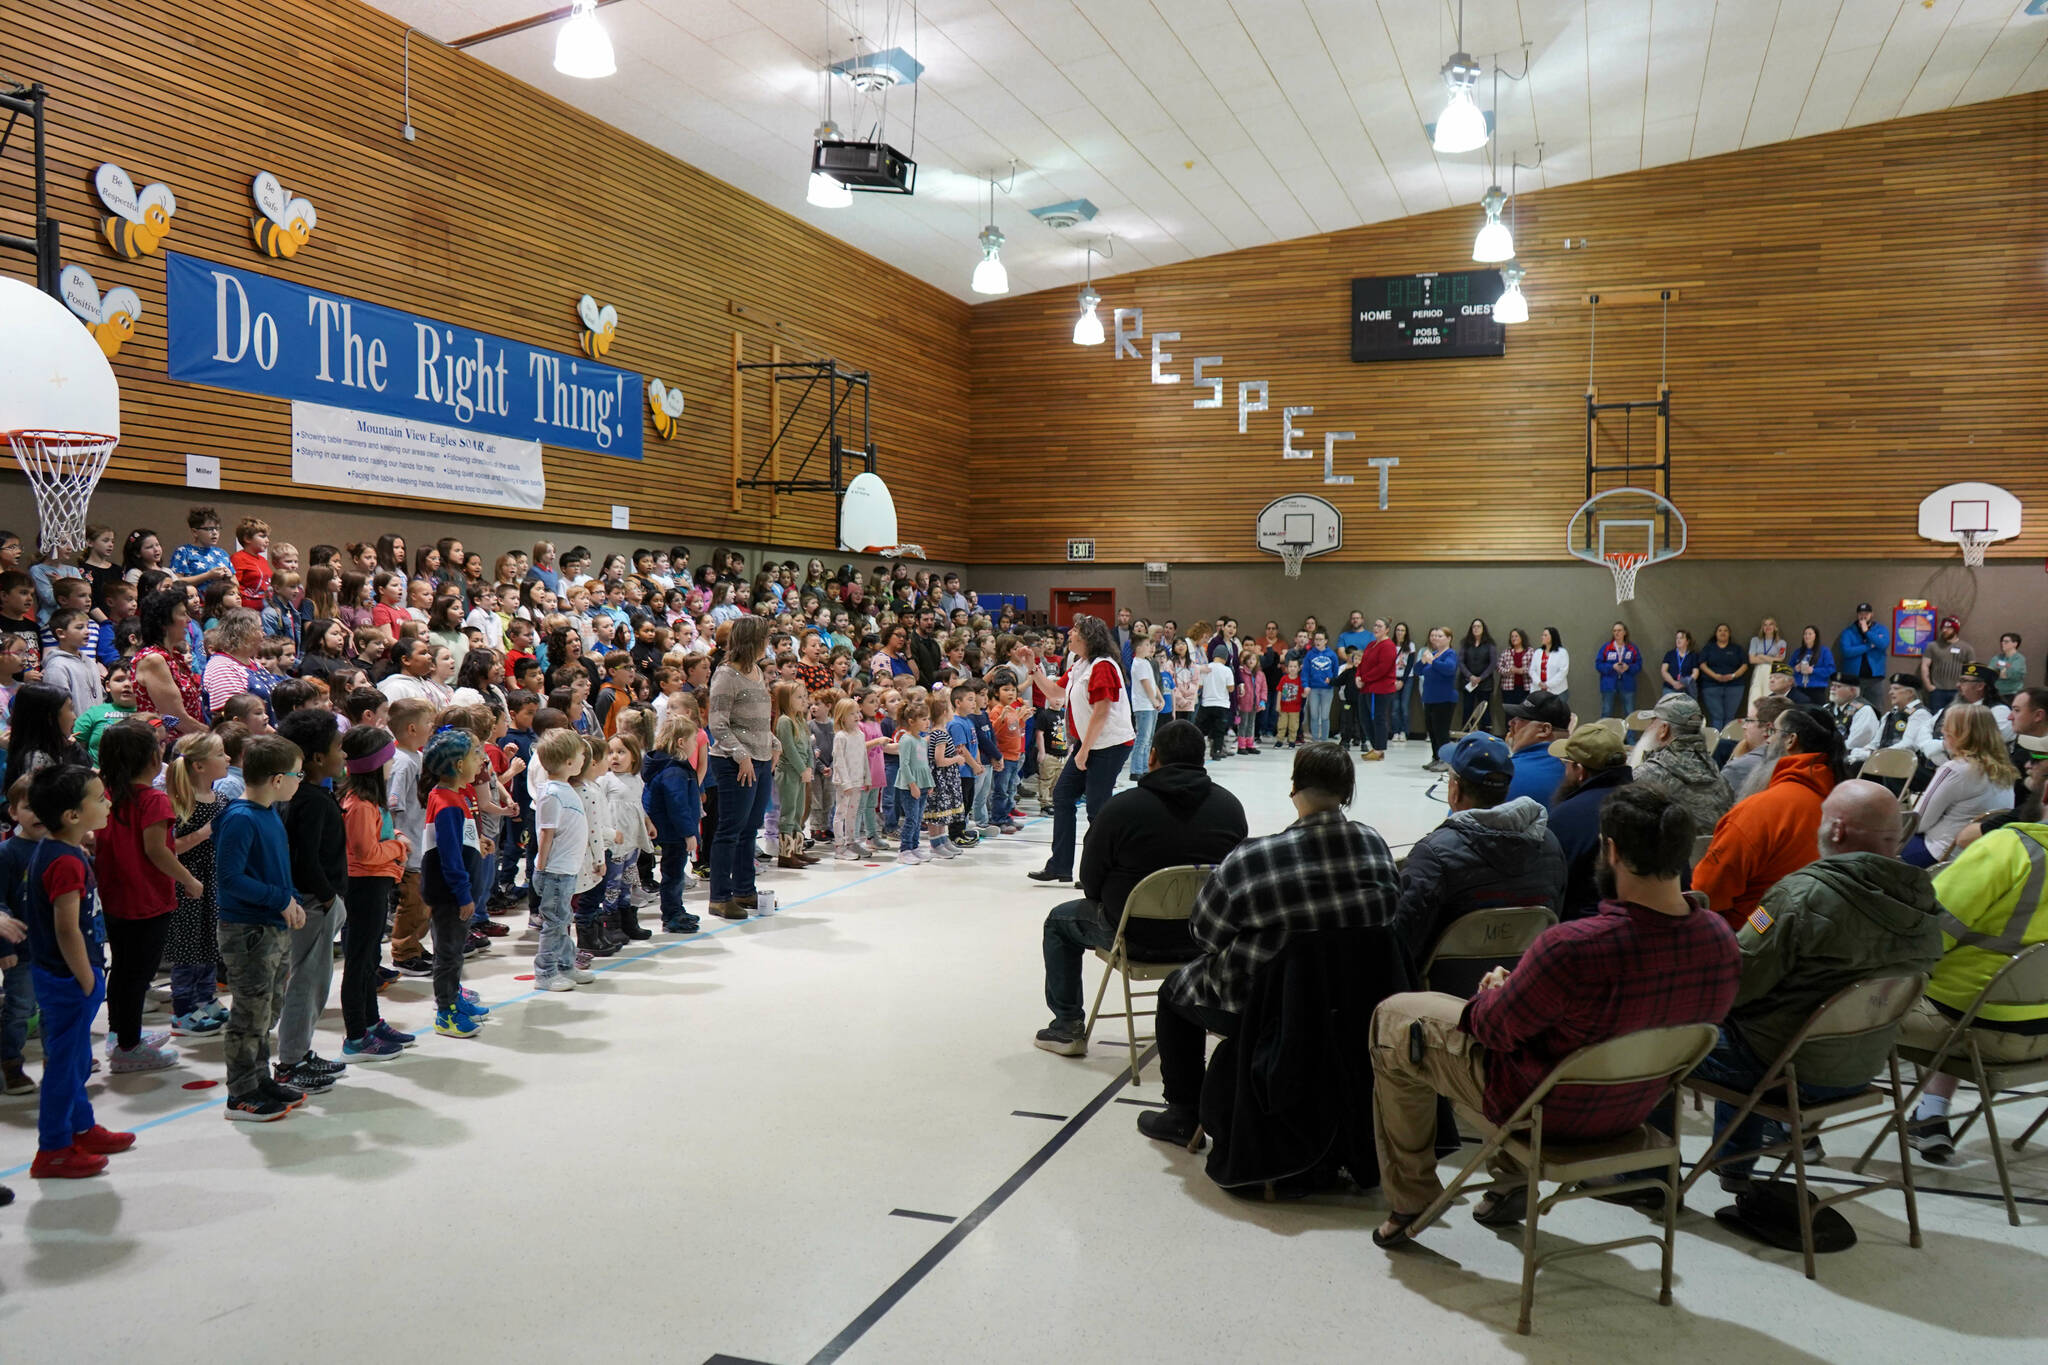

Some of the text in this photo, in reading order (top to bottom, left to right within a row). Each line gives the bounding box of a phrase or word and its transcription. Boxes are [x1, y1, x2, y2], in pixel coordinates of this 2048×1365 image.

[111, 175, 123, 187] Be
[265, 182, 275, 195] Be
[102, 188, 139, 214] Respectful
[263, 197, 279, 214] Safe
[73, 275, 85, 289] Be
[67, 291, 101, 317] Positive
[1360, 310, 1392, 322] HOME
[1412, 309, 1443, 319] PERIOD
[1415, 328, 1440, 337] POSS.
[1412, 336, 1441, 346] BONUS
[211, 270, 623, 448] Do The Right Thing!
[1114, 308, 1400, 511] RESPECT
[300, 430, 327, 444] Showing
[327, 434, 342, 445] table
[343, 438, 367, 449] manners
[368, 440, 379, 450] and
[381, 443, 401, 455] keeping
[402, 446, 411, 454] our
[356, 420, 496, 454] Mountain View Eagles SOAR at:
[300, 446, 324, 460] Staying
[324, 450, 330, 459] in
[330, 452, 341, 460] our
[341, 453, 357, 462] seats
[358, 455, 369, 464] and
[370, 456, 388, 468] raising
[388, 459, 398, 468] our
[399, 460, 415, 470] hands
[424, 464, 436, 473] help
[447, 453, 471, 465] Following
[499, 461, 507, 469] the
[195, 467, 213, 475] Miller
[461, 470, 474, 479] quiet
[491, 473, 501, 482] and
[351, 470, 370, 482] Facing
[370, 473, 380, 481] the
[454, 482, 465, 490] and
[1072, 543, 1090, 557] EXIT
